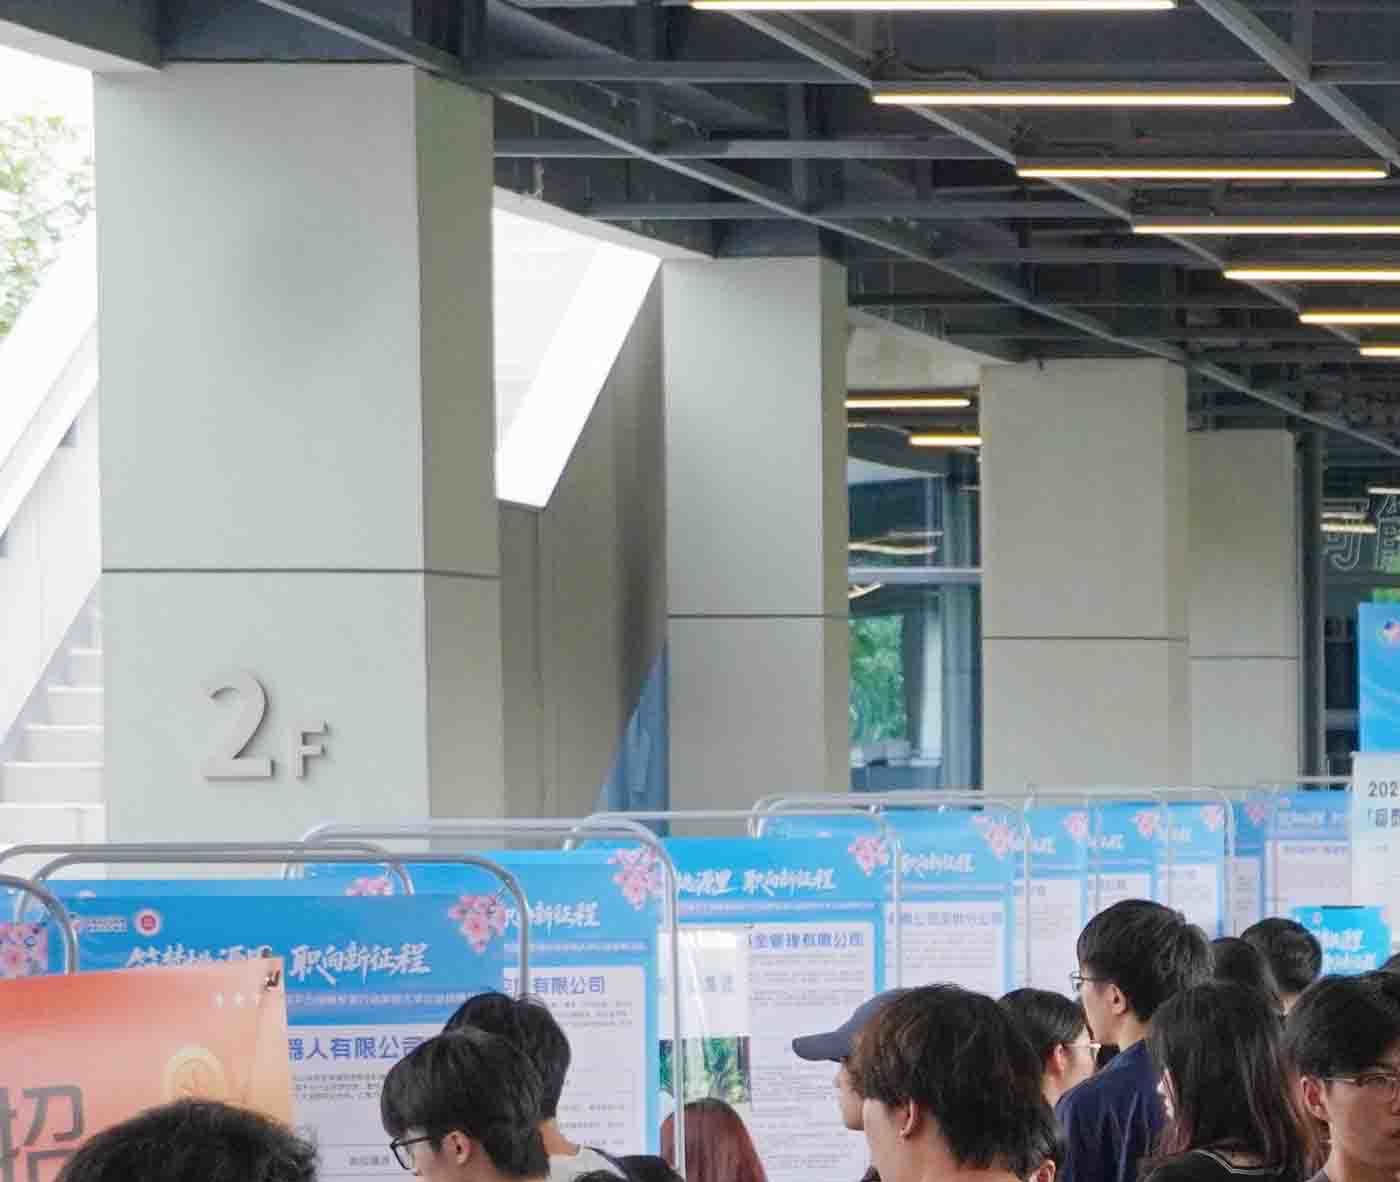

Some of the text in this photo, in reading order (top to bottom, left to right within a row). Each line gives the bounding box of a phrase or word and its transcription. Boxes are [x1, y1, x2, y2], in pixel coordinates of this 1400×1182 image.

[203, 670, 330, 780] 2F
[289, 941, 433, 985] 职向新征程
